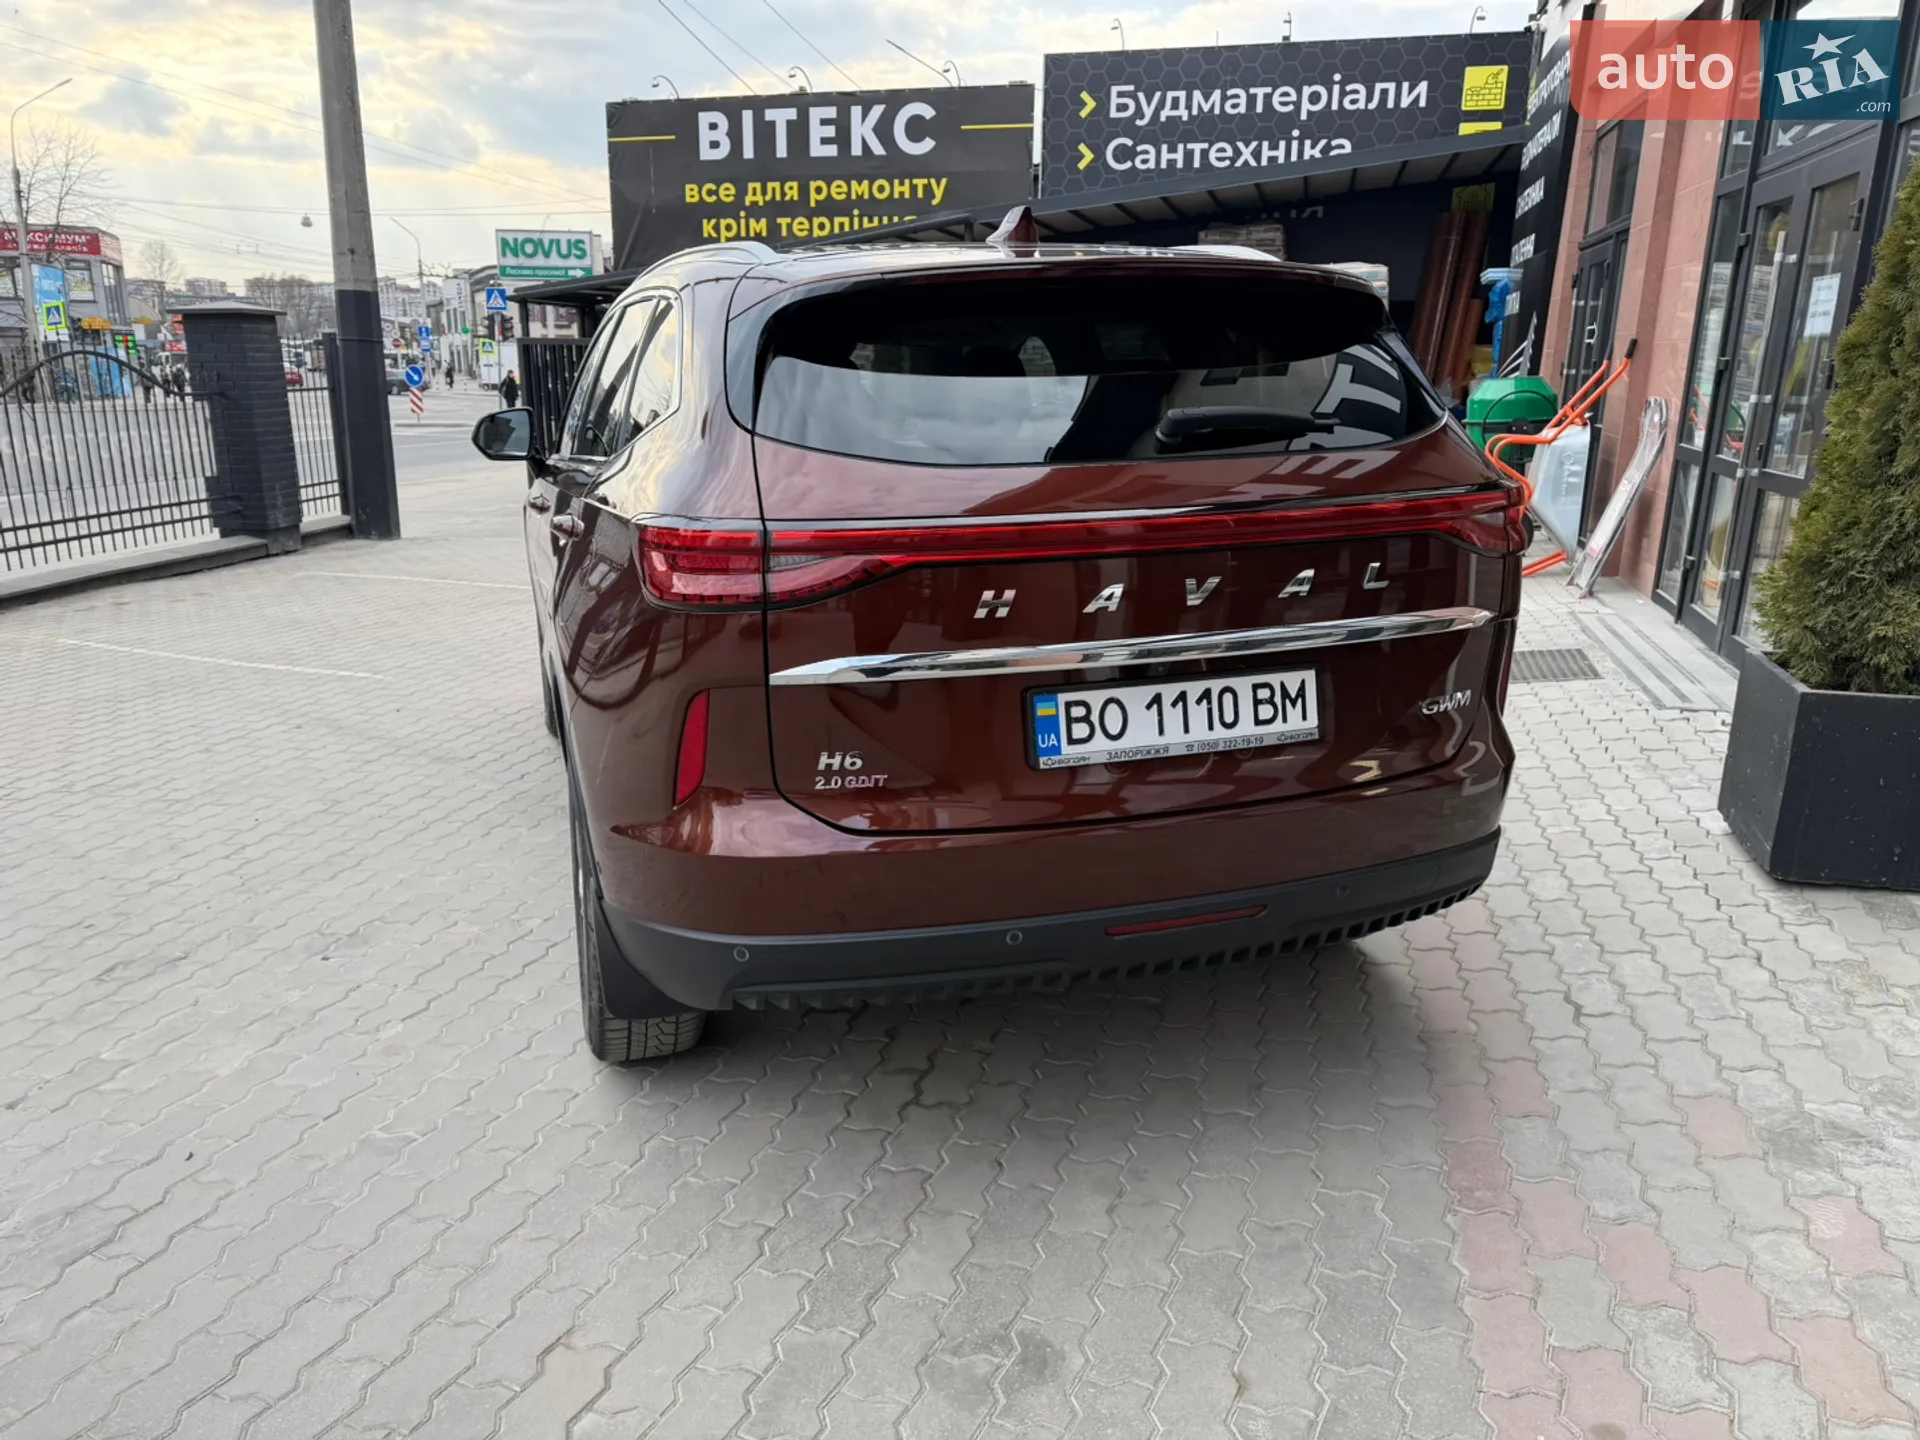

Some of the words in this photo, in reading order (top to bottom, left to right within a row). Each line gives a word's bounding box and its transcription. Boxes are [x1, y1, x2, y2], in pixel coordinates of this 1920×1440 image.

[1108, 74, 1428, 126] Будматеріали
[698, 102, 937, 161] ВІТЕКС
[684, 181, 736, 204] все
[744, 180, 799, 207] для
[809, 177, 948, 206] ремонту
[702, 210, 768, 242] крім
[500, 237, 587, 260] NOVUS
[973, 562, 1391, 619] HAVAL
[1063, 696, 1129, 746] BO
[1145, 685, 1240, 737] 1110
[1251, 678, 1308, 727] BM
[1421, 689, 1472, 715] GWM
[1038, 733, 1059, 749] UA
[1106, 746, 1170, 761] ЗАПОРІЖЖЯ
[1222, 737, 1264, 749] 322-19-19
[817, 750, 864, 771] H6
[814, 776, 842, 790] 2.0
